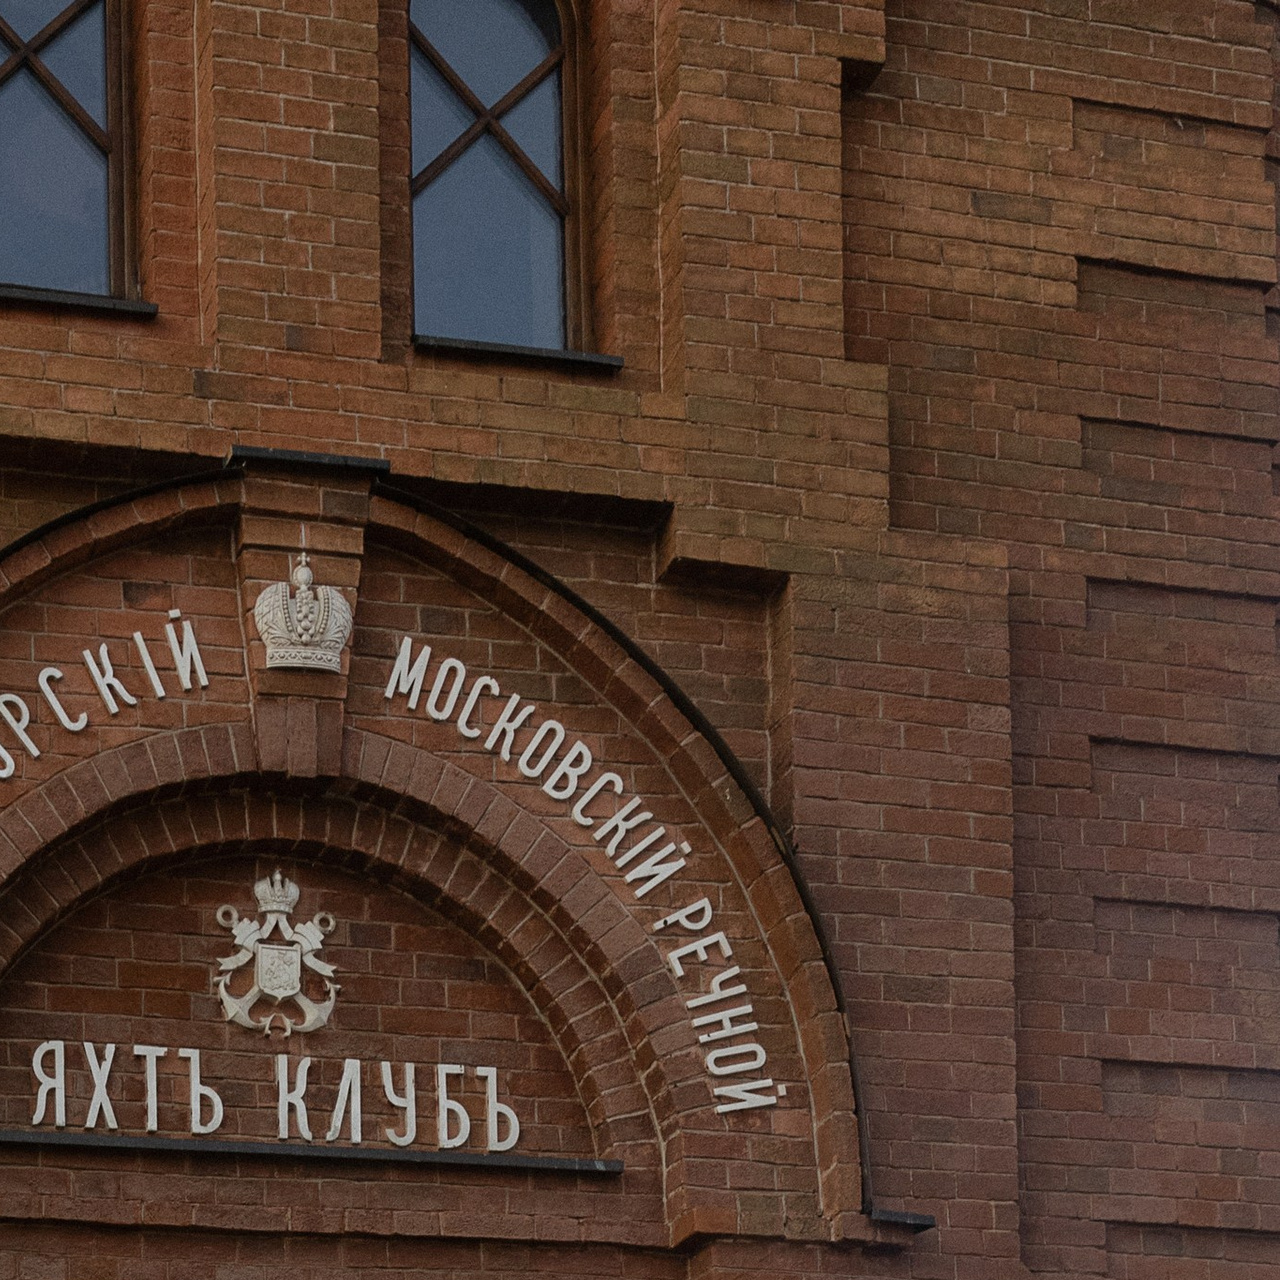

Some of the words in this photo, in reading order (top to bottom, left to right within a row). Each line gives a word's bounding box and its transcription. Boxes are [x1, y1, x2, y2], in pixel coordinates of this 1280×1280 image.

[652, 897, 787, 1114] РЕЧНОЙ
[32, 1040, 224, 1134] ЯХТЪ
[277, 1054, 521, 1152] КЛУБЪ
